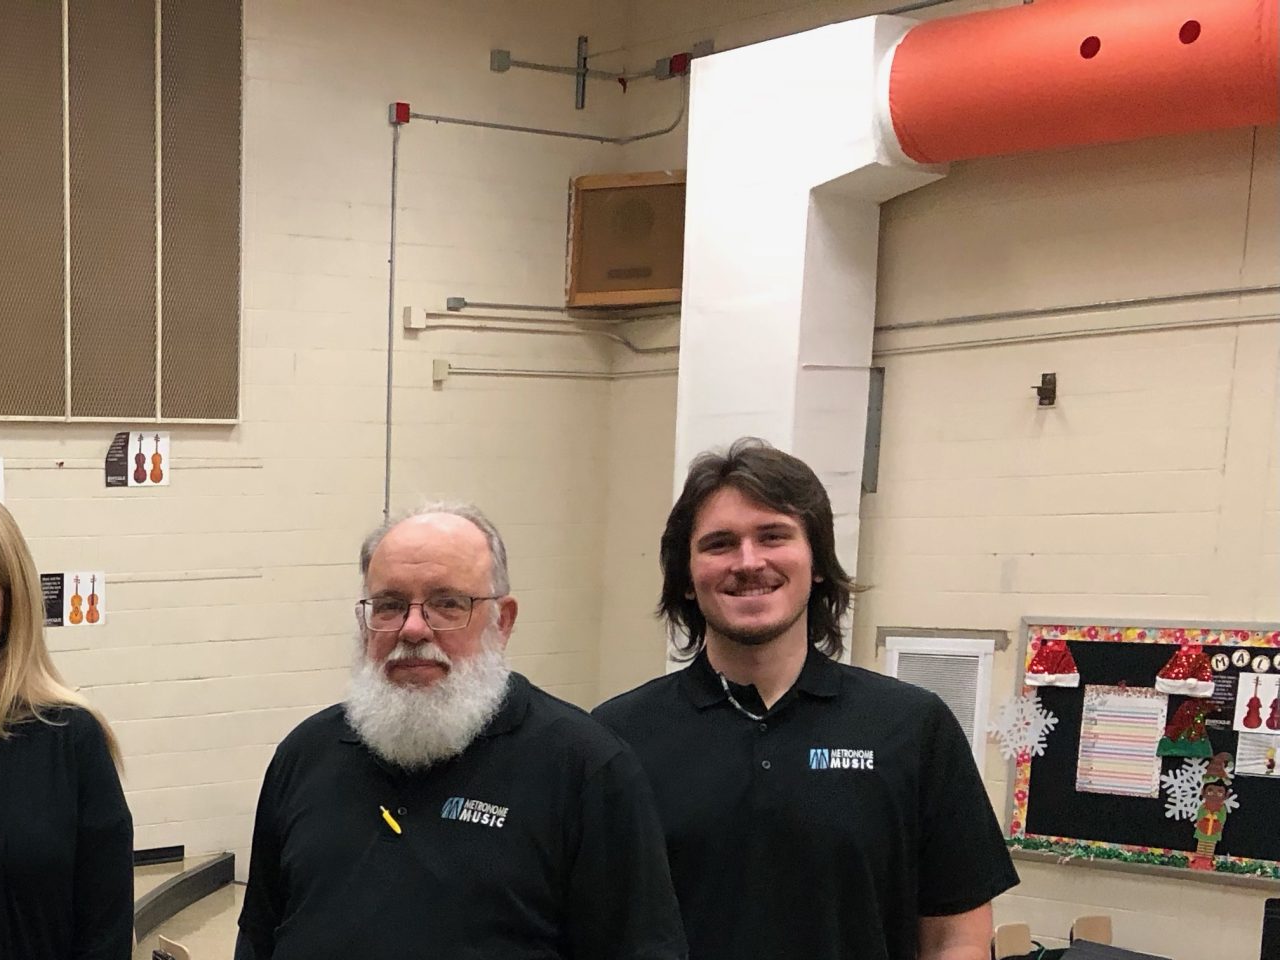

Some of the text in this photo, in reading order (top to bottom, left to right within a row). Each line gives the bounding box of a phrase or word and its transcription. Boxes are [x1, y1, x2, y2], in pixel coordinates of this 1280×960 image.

[830, 748, 875, 760] METRONOME
[829, 757, 875, 770] MUSIC
[463, 798, 510, 818] METRONOME
[458, 808, 506, 828] MUSIC
